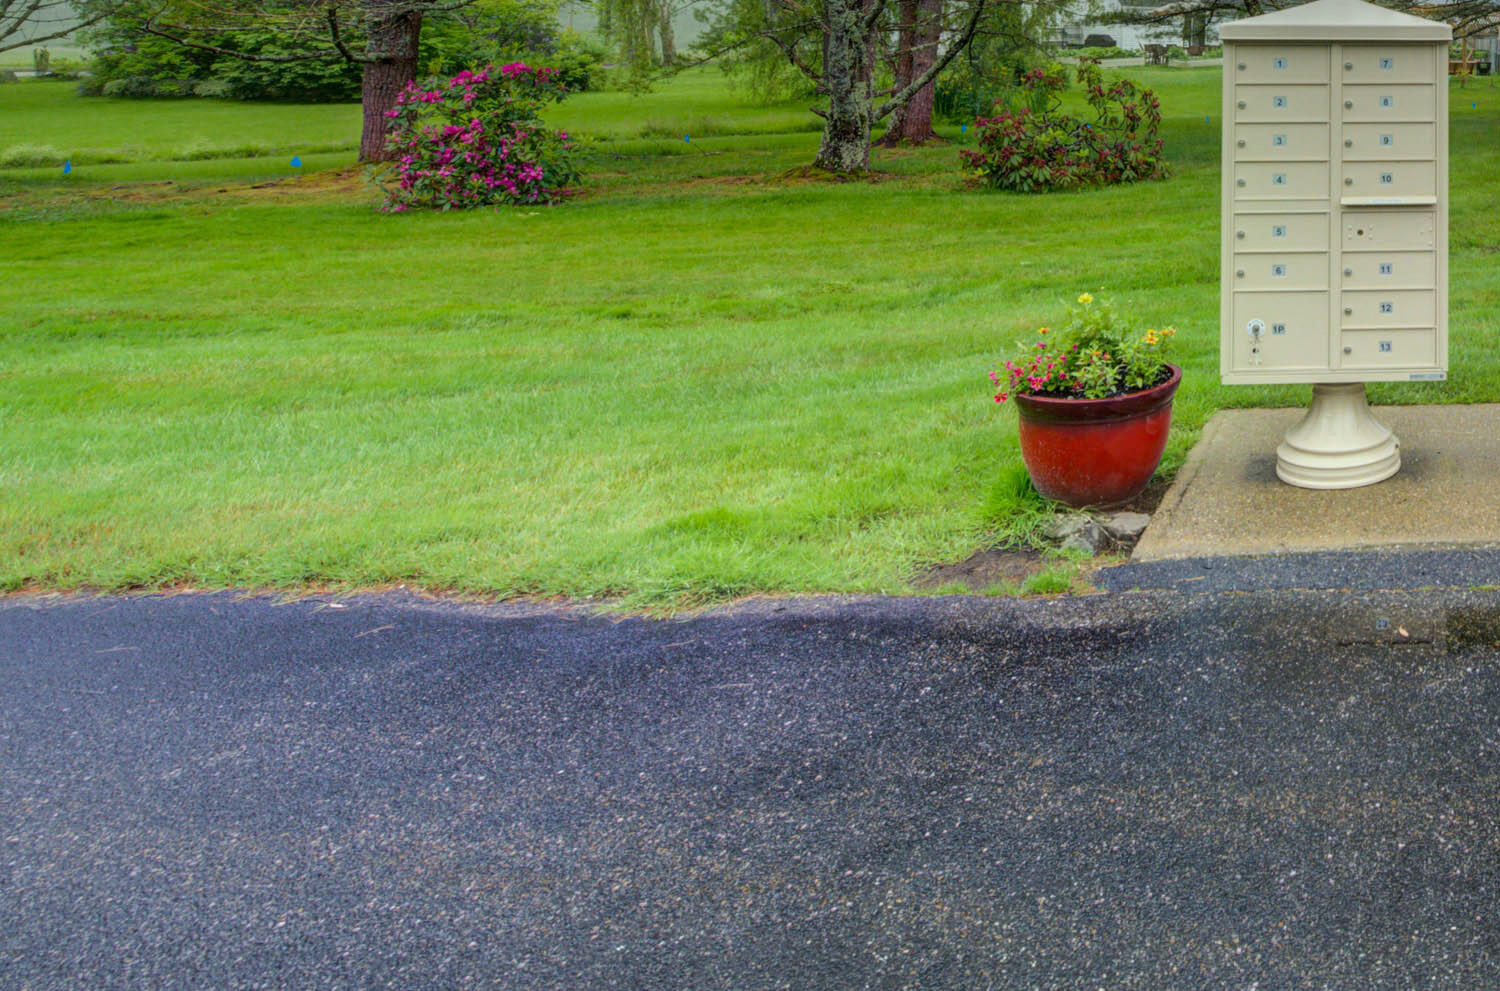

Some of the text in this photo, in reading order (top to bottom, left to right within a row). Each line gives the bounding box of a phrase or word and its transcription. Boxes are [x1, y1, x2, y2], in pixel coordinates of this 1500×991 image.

[1381, 174, 1392, 183] 10
[1380, 264, 1391, 274] 11
[1380, 303, 1393, 313] 12
[1272, 324, 1285, 334] 1P
[1380, 341, 1392, 352] 13
